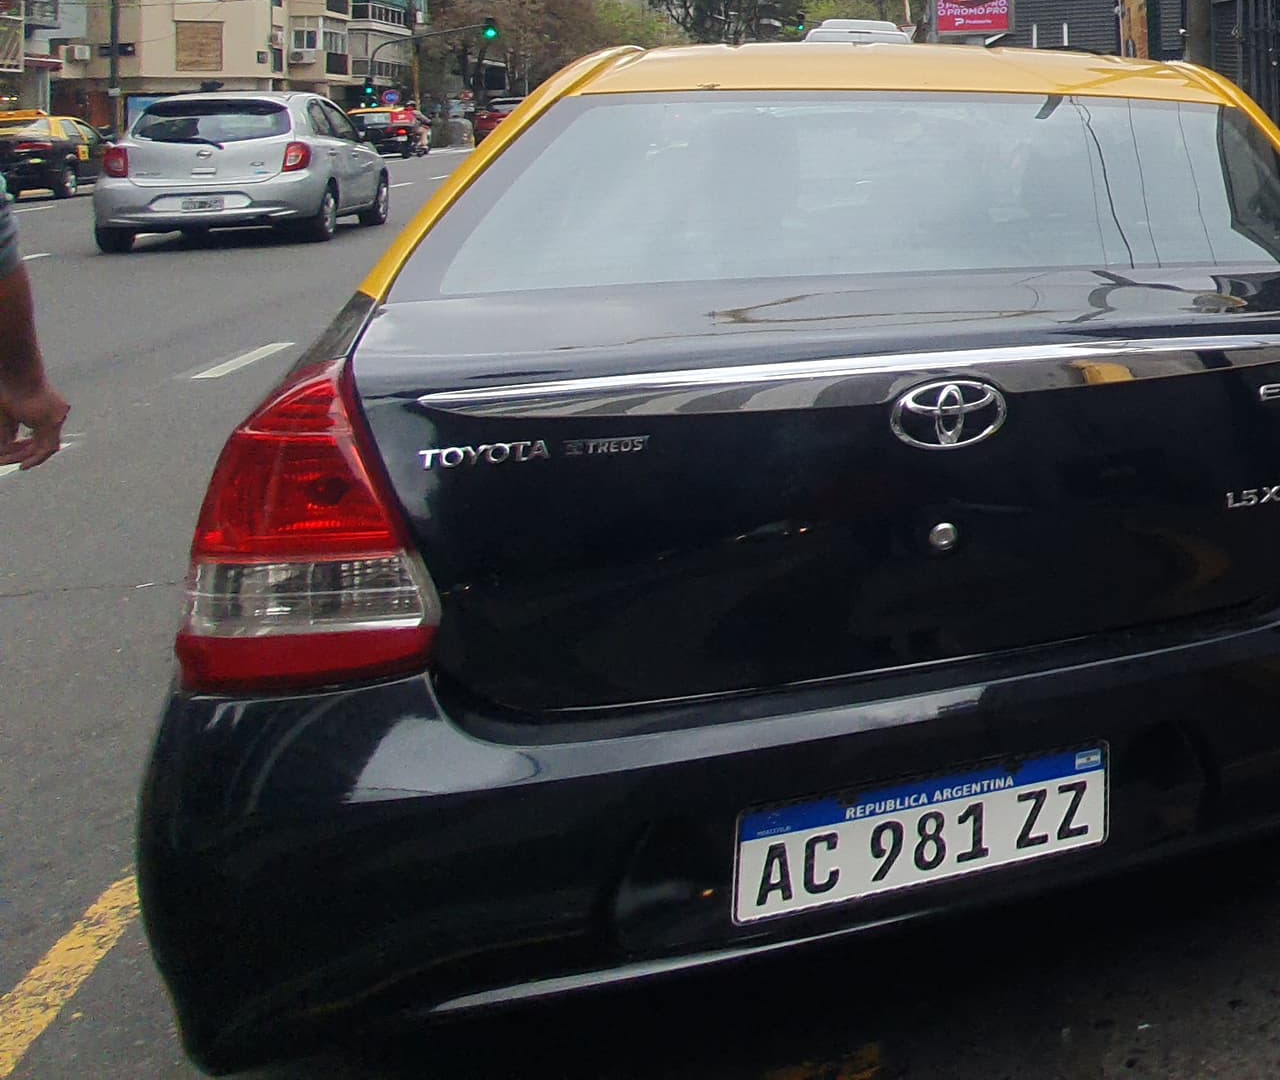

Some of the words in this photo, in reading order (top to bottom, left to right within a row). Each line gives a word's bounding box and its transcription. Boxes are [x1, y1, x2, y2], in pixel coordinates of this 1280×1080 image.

[947, 7, 985, 16] PROMO
[418, 439, 551, 471] TOYOTA
[845, 792, 929, 820] REPUBLICA
[932, 775, 1015, 803] ARGENTINA
[756, 831, 841, 907] AC
[869, 801, 990, 882] 981
[1015, 780, 1090, 850] ZZ
